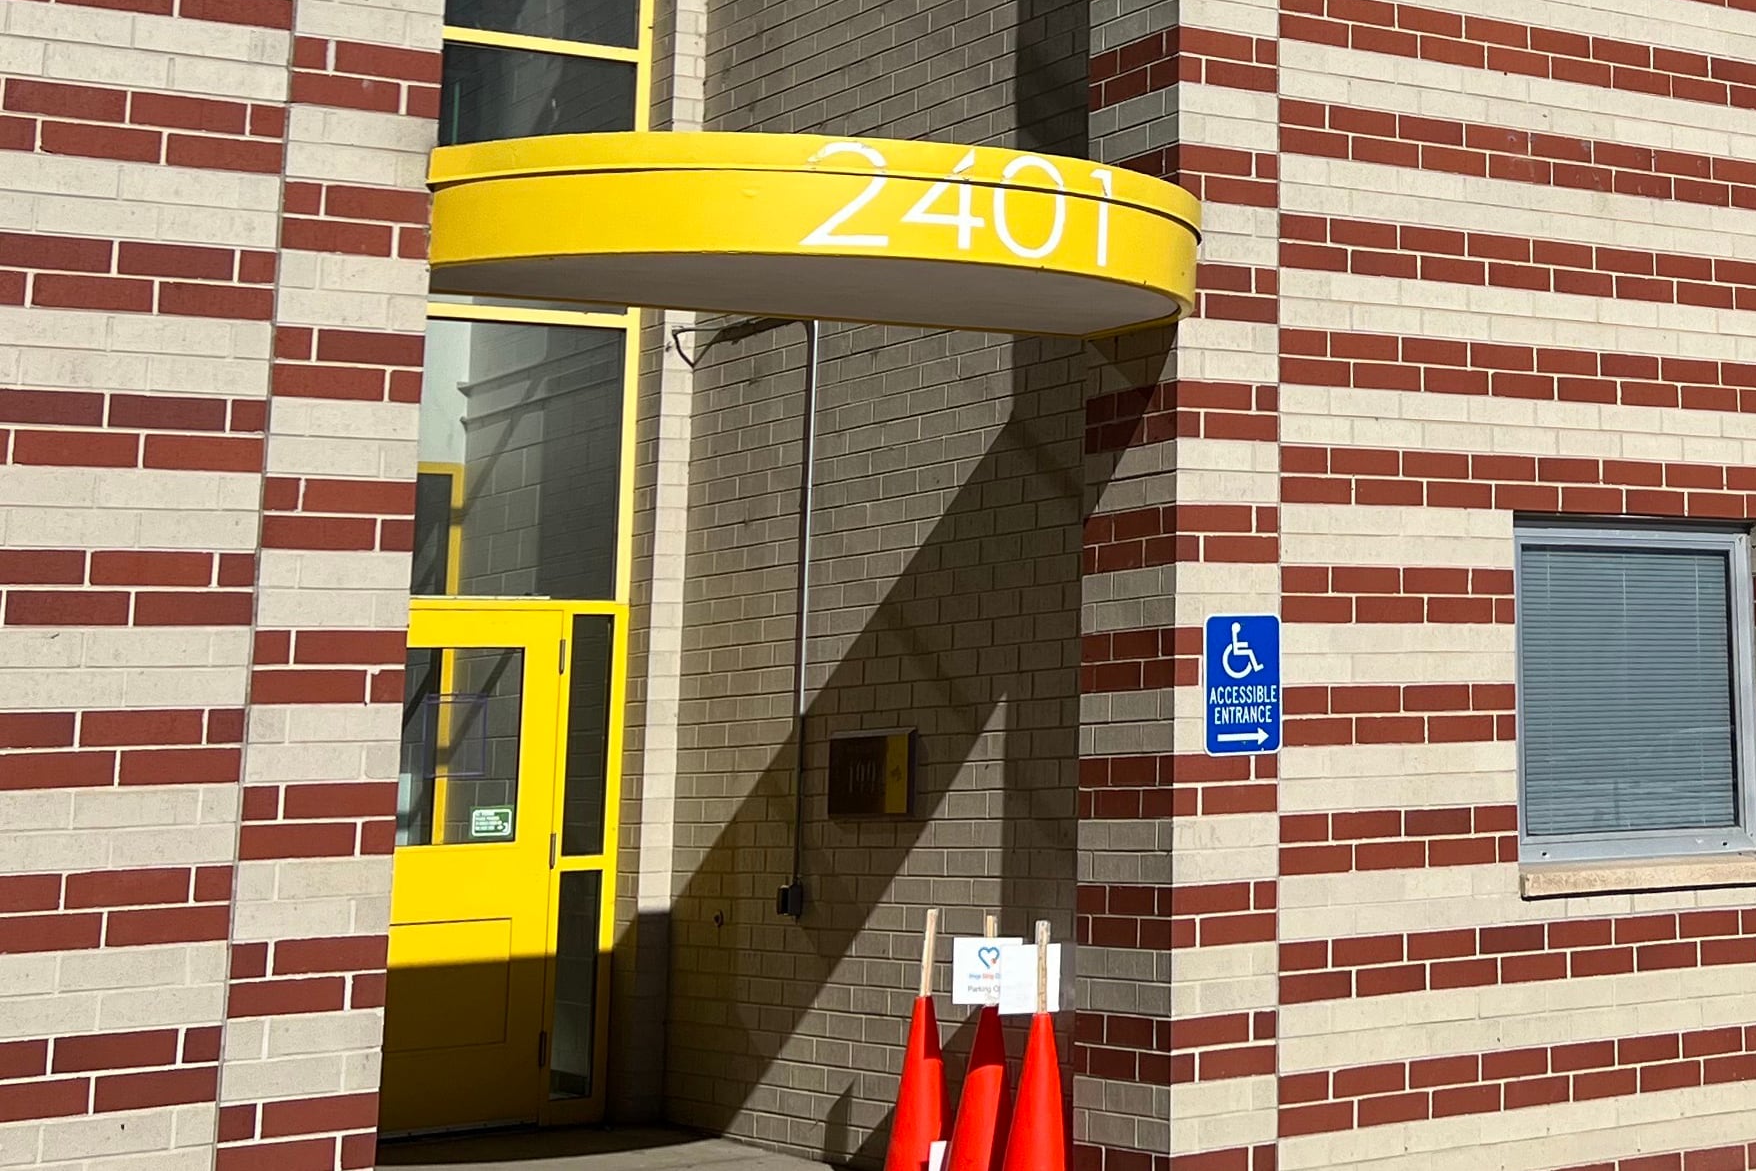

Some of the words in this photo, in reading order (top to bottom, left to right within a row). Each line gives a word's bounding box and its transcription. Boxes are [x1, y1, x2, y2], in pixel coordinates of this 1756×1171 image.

[799, 140, 1113, 268] 2401
[1209, 685, 1278, 705] ACCESSIBLE
[1214, 705, 1273, 725] ENTRANCE
